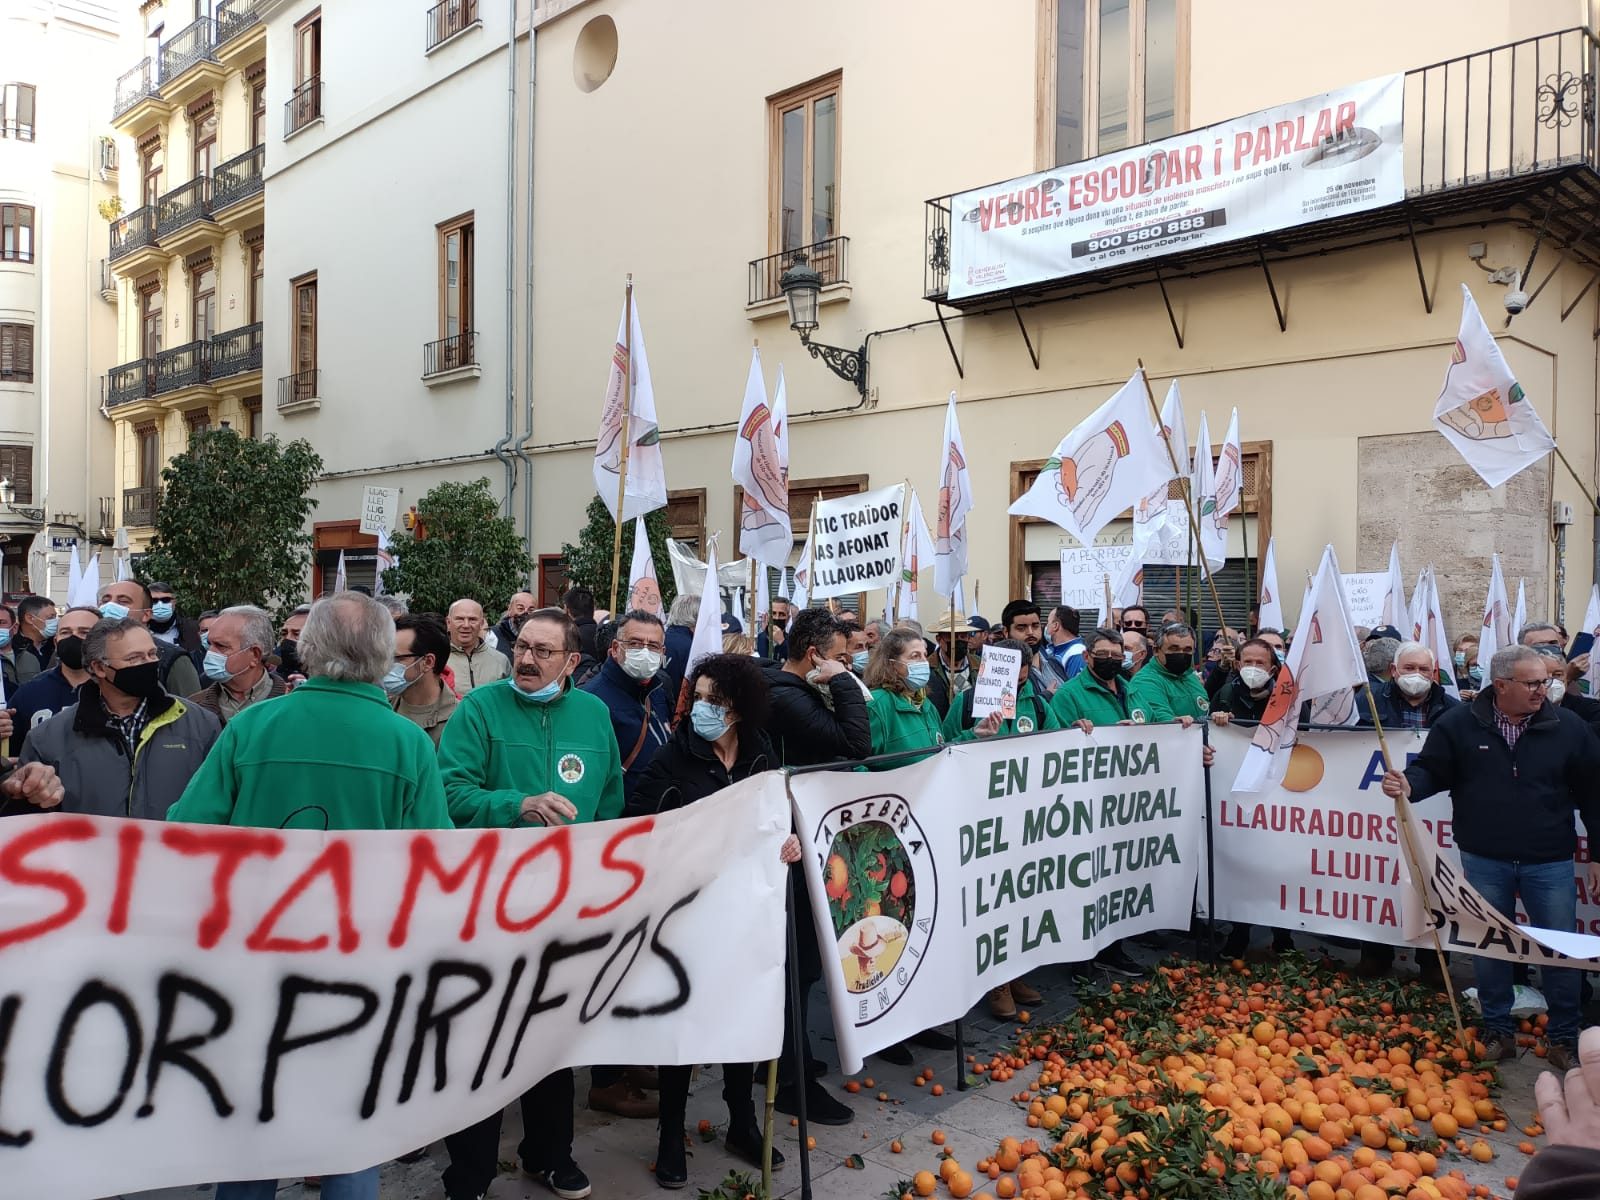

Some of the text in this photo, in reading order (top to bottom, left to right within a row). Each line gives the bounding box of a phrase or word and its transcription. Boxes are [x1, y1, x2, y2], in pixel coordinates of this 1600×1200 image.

[979, 180, 1062, 232] VEURE,
[1069, 144, 1203, 211] ESCOLTAR
[1233, 101, 1357, 171] PARLAR
[1053, 220, 1064, 230] que
[1085, 212, 1100, 222] dona
[1112, 206, 1124, 215] una
[1153, 196, 1162, 206] de
[1160, 204, 1168, 213] de
[1088, 215, 1206, 252] 900 580 888
[1098, 252, 1107, 260] al
[1109, 248, 1126, 258] 016
[366, 513, 386, 523] LLOC
[840, 502, 899, 530] TRAÏDOR
[838, 531, 890, 559] AFONAT
[1062, 552, 1077, 563] LA
[1106, 547, 1131, 559] PLAG
[1072, 563, 1093, 575] DEL
[1063, 587, 1105, 606] MINIS
[988, 742, 1161, 799] EN DEFENSA
[840, 800, 925, 856] RIBERA
[959, 787, 1182, 867] DEL MÓN RURAL
[1220, 800, 1398, 844] LLAURADORS
[975, 833, 1181, 918] L'AGRICULTURA
[1280, 884, 1402, 928] I LLUITA
[975, 924, 1010, 977] DE
[1020, 908, 1062, 954] LA
